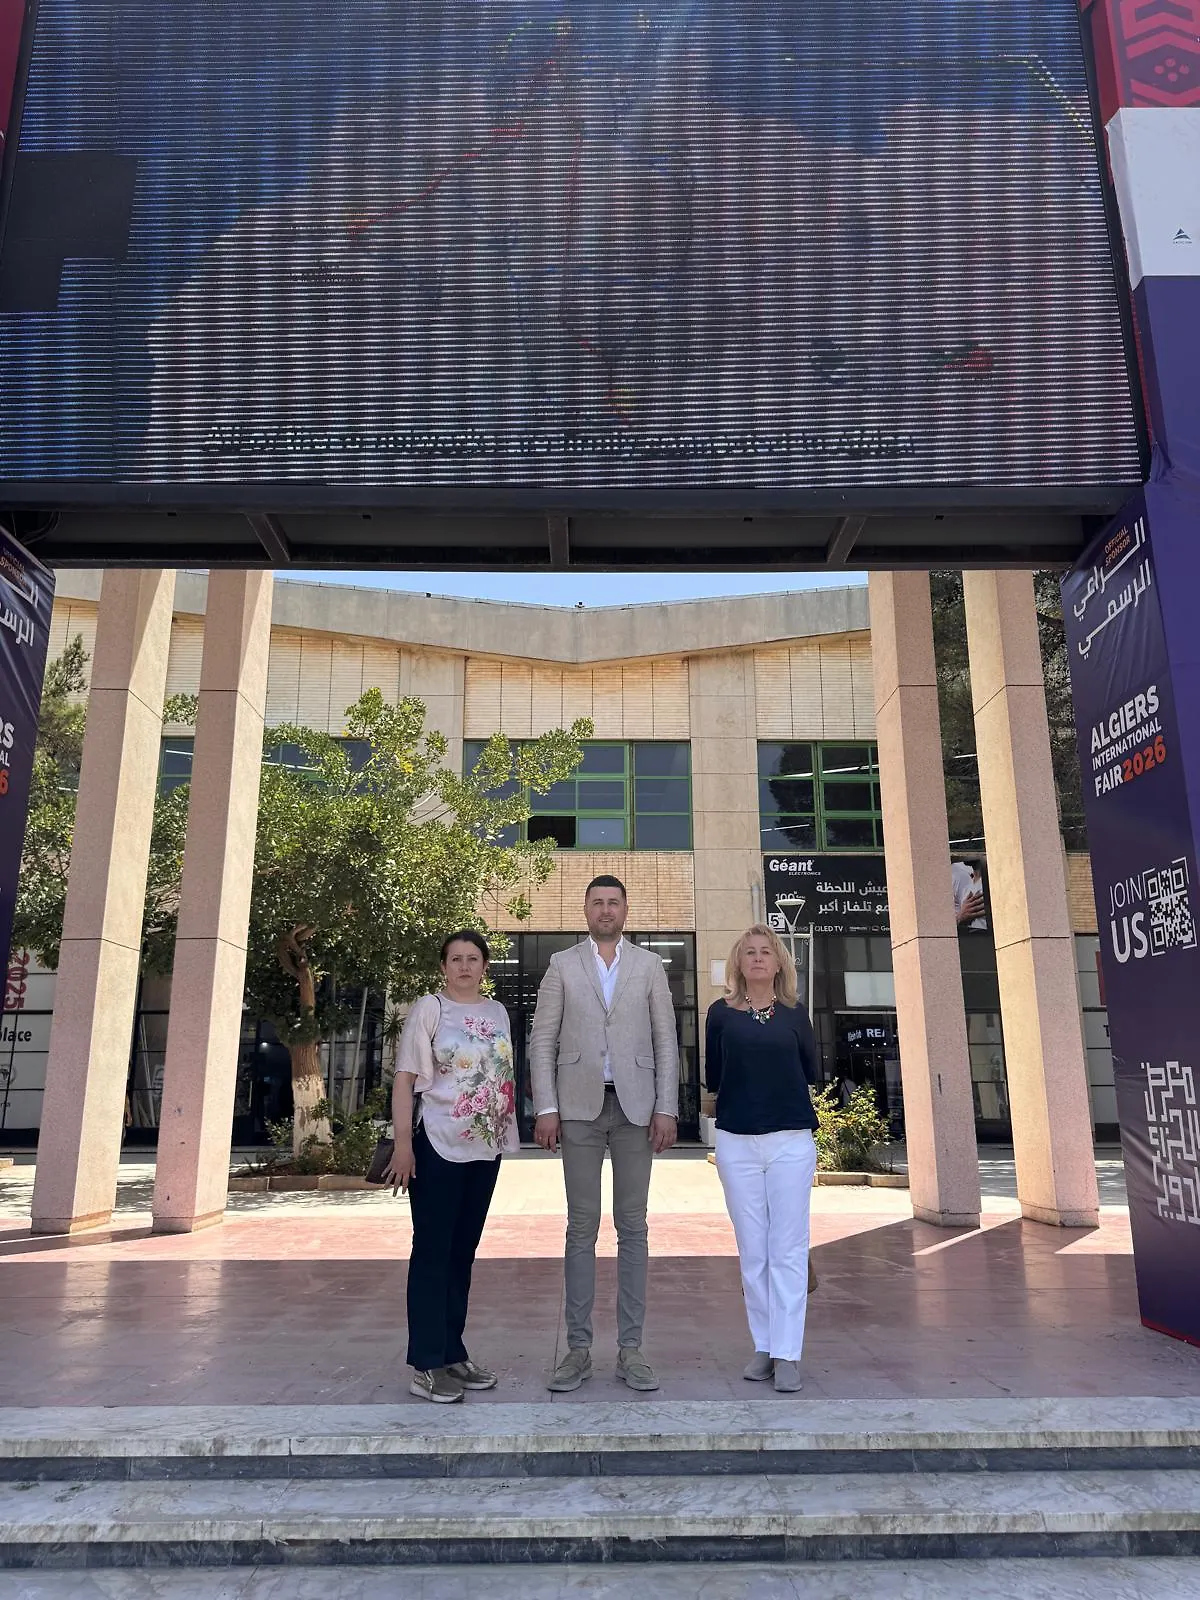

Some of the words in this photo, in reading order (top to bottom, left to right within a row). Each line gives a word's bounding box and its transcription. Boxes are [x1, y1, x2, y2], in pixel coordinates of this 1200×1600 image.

[1105, 525, 1129, 554] OFFICIAL
[1105, 535, 1131, 567] SPONSOR
[1090, 685, 1159, 754] ALGIERS
[1092, 717, 1162, 771] INTERNATIONAL
[769, 859, 815, 872] Géant
[816, 881, 856, 894] اللحظة
[1109, 876, 1143, 916] JOIN
[818, 899, 839, 915] أكبر
[842, 900, 873, 915] تلفاز
[1110, 911, 1149, 964] US
[0, 1027, 32, 1042] lace
